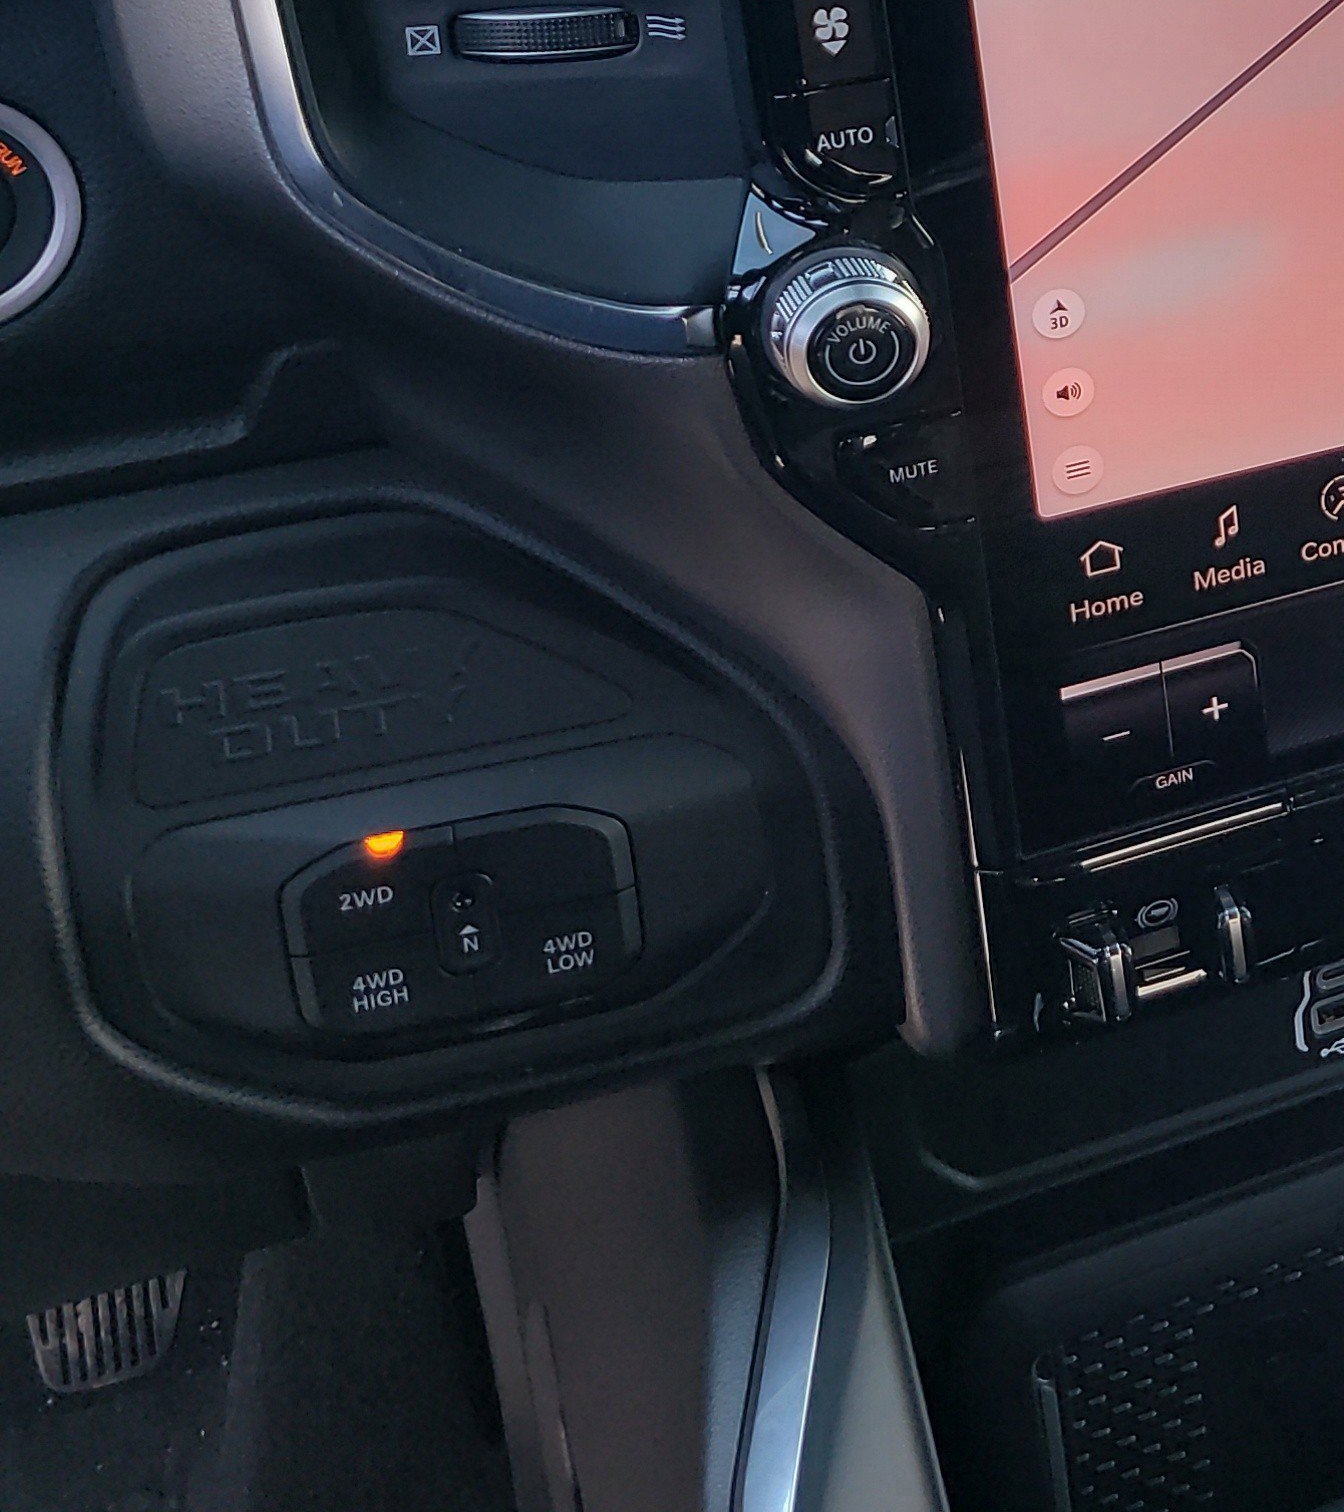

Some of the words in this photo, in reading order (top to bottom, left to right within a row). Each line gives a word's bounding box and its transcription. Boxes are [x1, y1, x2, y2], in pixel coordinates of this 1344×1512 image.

[816, 126, 875, 153] AUTO
[827, 316, 891, 345] VOLUME
[1050, 315, 1069, 330] 3D
[889, 459, 939, 483] MUTE
[1193, 557, 1266, 591] Media
[1069, 590, 1144, 623] Home
[1154, 767, 1194, 789] GAIN
[339, 885, 394, 912] 2WD
[463, 934, 479, 953] N
[543, 931, 594, 956] 4WD
[546, 950, 595, 975] LOW
[353, 968, 404, 992] 4WD
[352, 986, 410, 1014] HIGH
